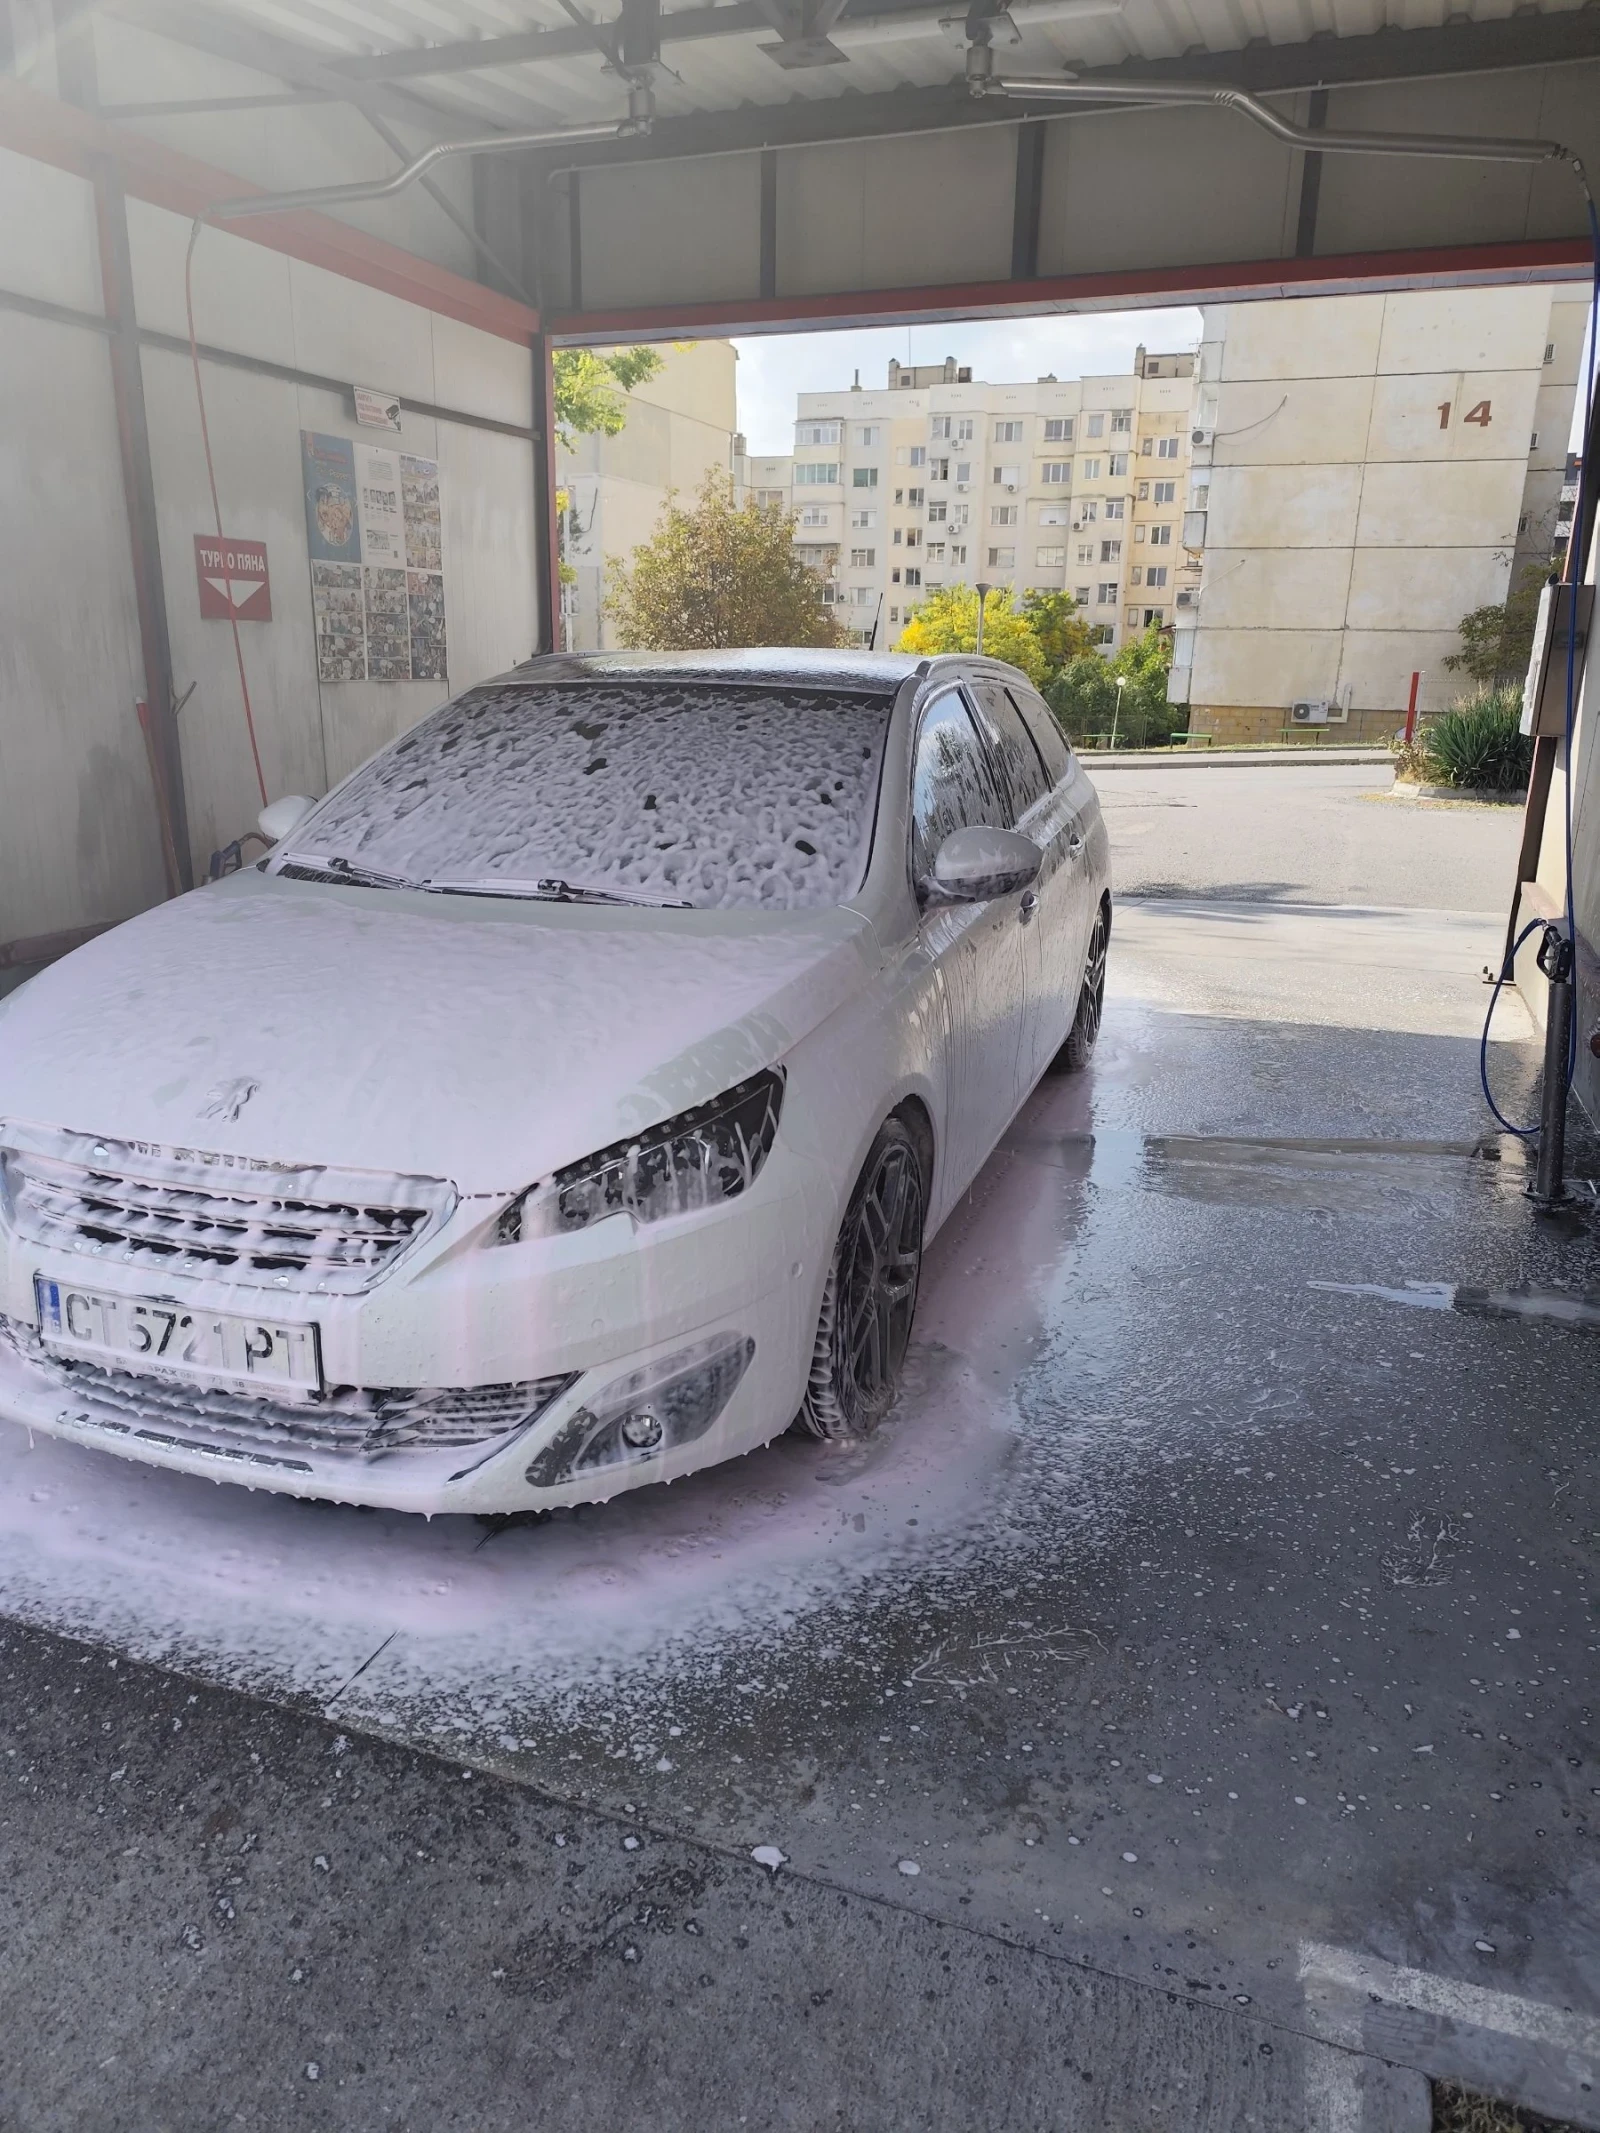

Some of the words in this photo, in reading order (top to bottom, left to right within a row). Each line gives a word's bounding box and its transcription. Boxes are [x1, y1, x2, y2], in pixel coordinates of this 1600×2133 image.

[1437, 400, 1492, 430] 14
[236, 553, 266, 572] ПЯНА
[128, 1306, 230, 1369] 5721
